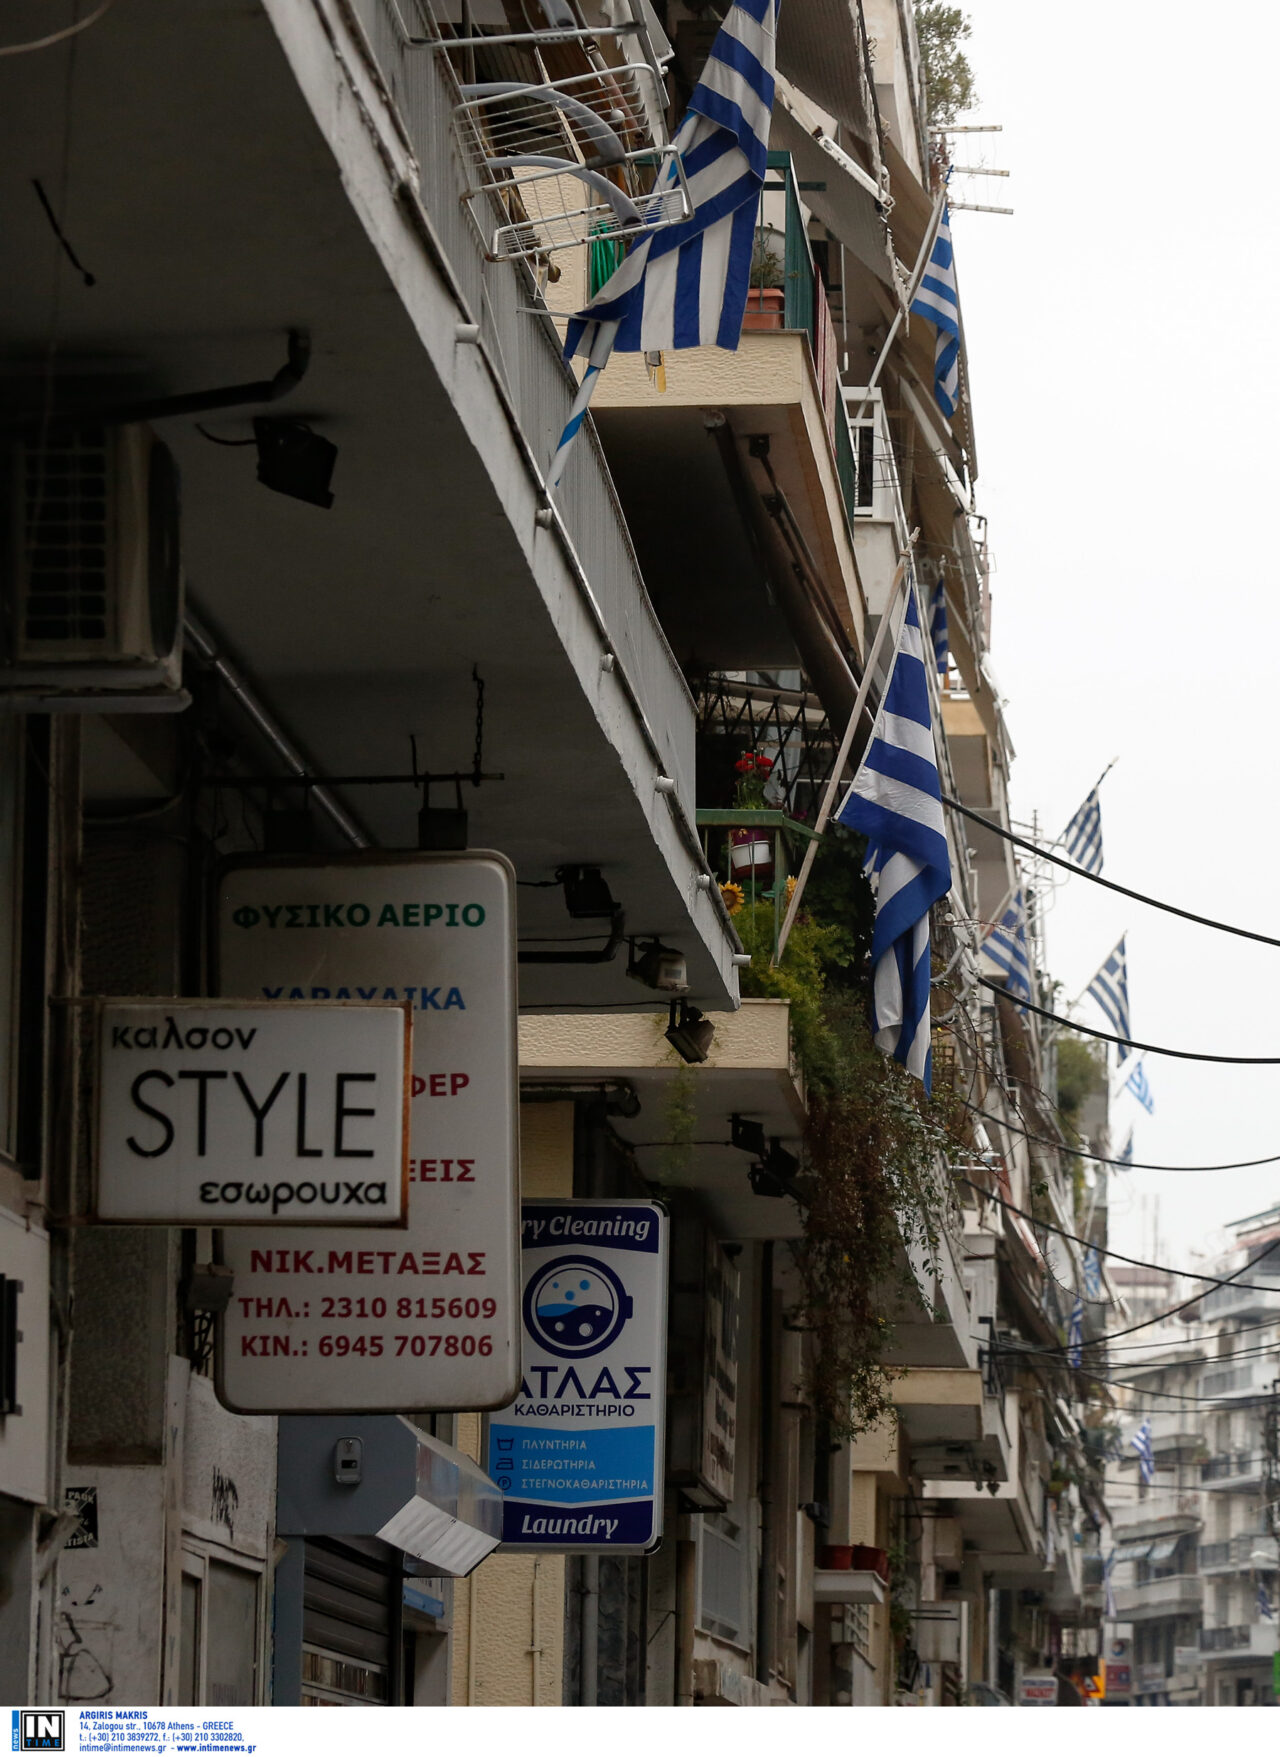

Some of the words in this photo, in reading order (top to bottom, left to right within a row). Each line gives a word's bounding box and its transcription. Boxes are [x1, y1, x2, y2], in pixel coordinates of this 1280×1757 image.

[231, 903, 371, 929] ΦΥΣΙΚΟ
[376, 903, 487, 928] ΑΕΡΙΟ
[111, 1015, 258, 1051] καλσον
[125, 1068, 377, 1159] STYLE
[199, 1180, 388, 1215] εσωρουχα
[549, 1215, 651, 1242] Cleaning
[250, 1250, 487, 1276] ΝΙΚ.ΜΕΤΑΞΑΣ
[238, 1297, 310, 1319] ΤΗΛ.:
[320, 1297, 388, 1319] 2310
[395, 1297, 498, 1320] 815609
[240, 1335, 308, 1357] ΚΙΝ.:
[317, 1335, 385, 1358] 6945
[393, 1335, 494, 1358] 707806
[513, 1403, 636, 1417] ΚΑΘΑΡΙΣΤΗΡΙΟ
[521, 1439, 588, 1450] ΠΛΥΝΤΗΡΙΑ
[520, 1458, 597, 1470] ΣΙΔΕΡΩΤΗΡΙΑ
[520, 1477, 649, 1490] ΣΤΕΓΝΟΚΑΘΑΡΙΣΤΗΡΙΑ
[521, 1513, 619, 1540] Laundry
